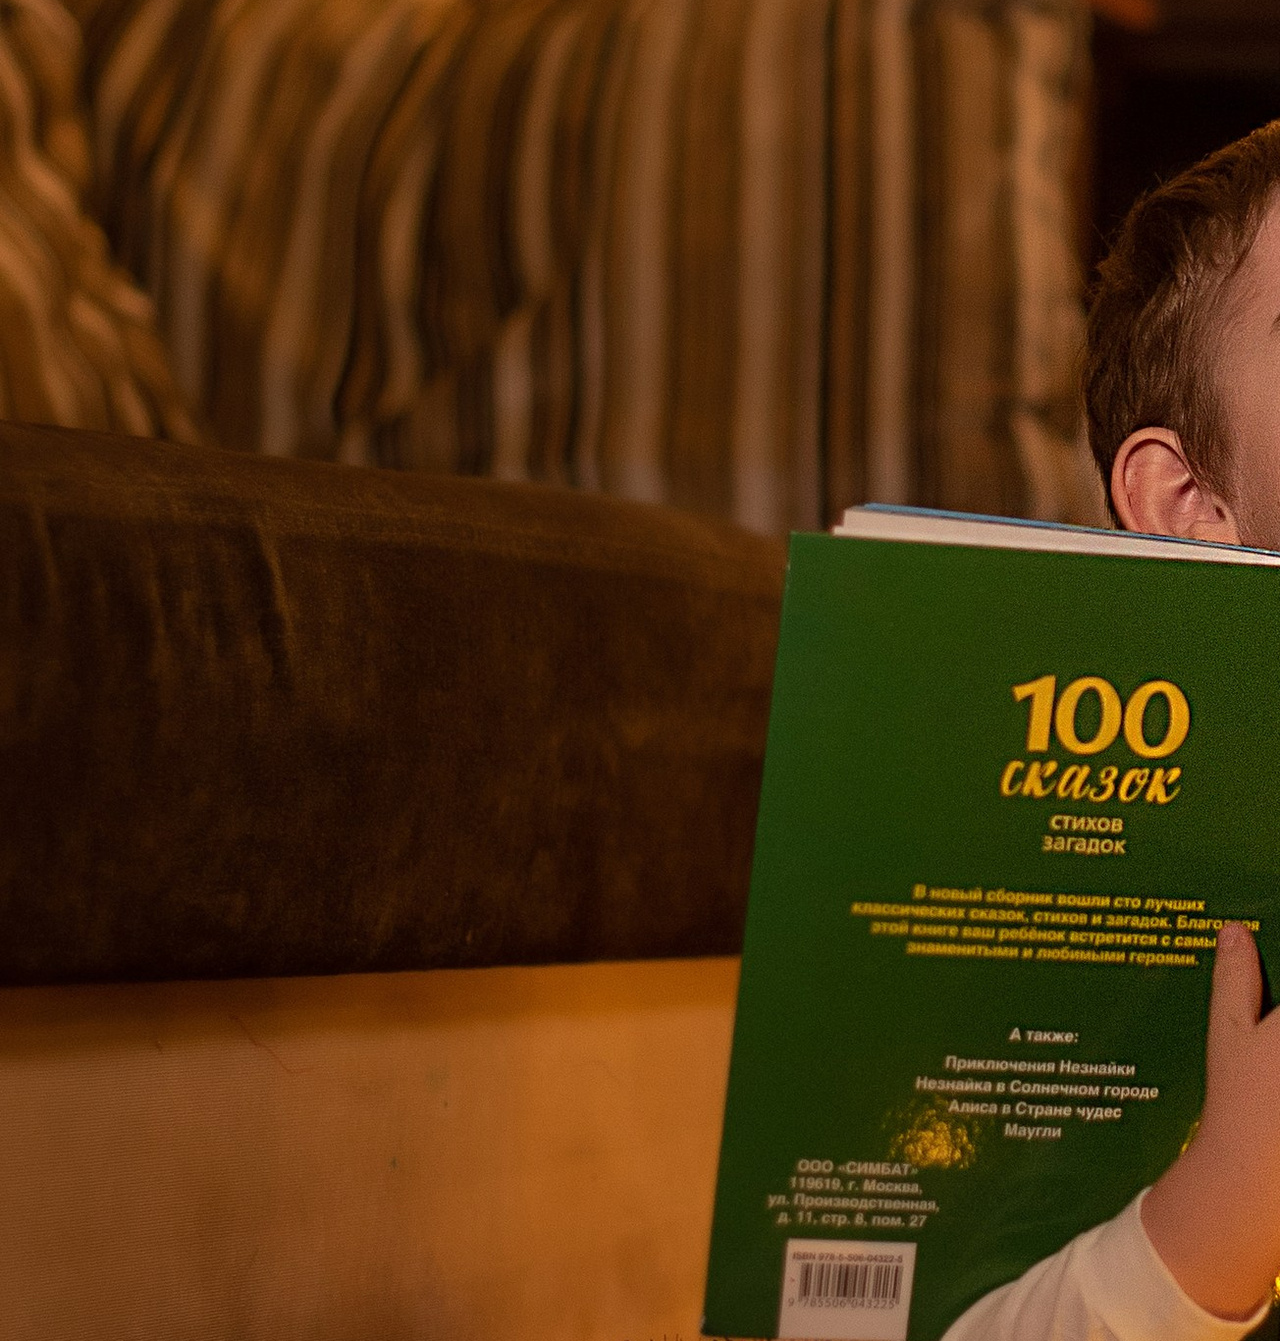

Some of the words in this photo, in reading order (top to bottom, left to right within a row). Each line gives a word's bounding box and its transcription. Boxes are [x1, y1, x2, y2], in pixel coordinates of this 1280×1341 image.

[1011, 674, 1190, 759] 100
[1000, 760, 1182, 804] сказок
[1042, 835, 1126, 855] загадок
[928, 886, 983, 902] новый
[985, 887, 1053, 906] сборник
[1057, 894, 1110, 908] вошли
[1113, 896, 1142, 908] сто
[1144, 897, 1205, 913] лучших
[1032, 911, 1088, 925] стихов
[1091, 913, 1102, 926] и
[1106, 914, 1173, 930] загадок.
[961, 926, 996, 941] ваш
[1069, 931, 1158, 947] встретится
[1161, 935, 1171, 946] с
[1021, 946, 1033, 959] и
[1035, 945, 1126, 962] любимыми
[1128, 951, 1200, 967] героями.
[1008, 1027, 1021, 1042] А
[1025, 1029, 1080, 1044] также:
[944, 1055, 1056, 1073] Приключения
[1059, 1060, 1136, 1077] Незнайки
[916, 1076, 992, 1093] Незнайка
[996, 1082, 1006, 1094] в
[1009, 1079, 1100, 1097] Солнечном
[1103, 1085, 1160, 1100] городе
[948, 1098, 998, 1115] Алиса
[1001, 1103, 1011, 1115] в
[1015, 1101, 1072, 1120] Стране
[1076, 1106, 1123, 1121] чудес
[1004, 1123, 1063, 1141] Маугли
[797, 1159, 834, 1174] ООО
[862, 1178, 924, 1196] Москва,
[767, 1194, 791, 1209] ул.
[792, 1192, 941, 1213] Производственная,
[821, 1213, 851, 1228] стр.
[871, 1215, 906, 1228] пом.
[909, 1215, 928, 1229] 27
